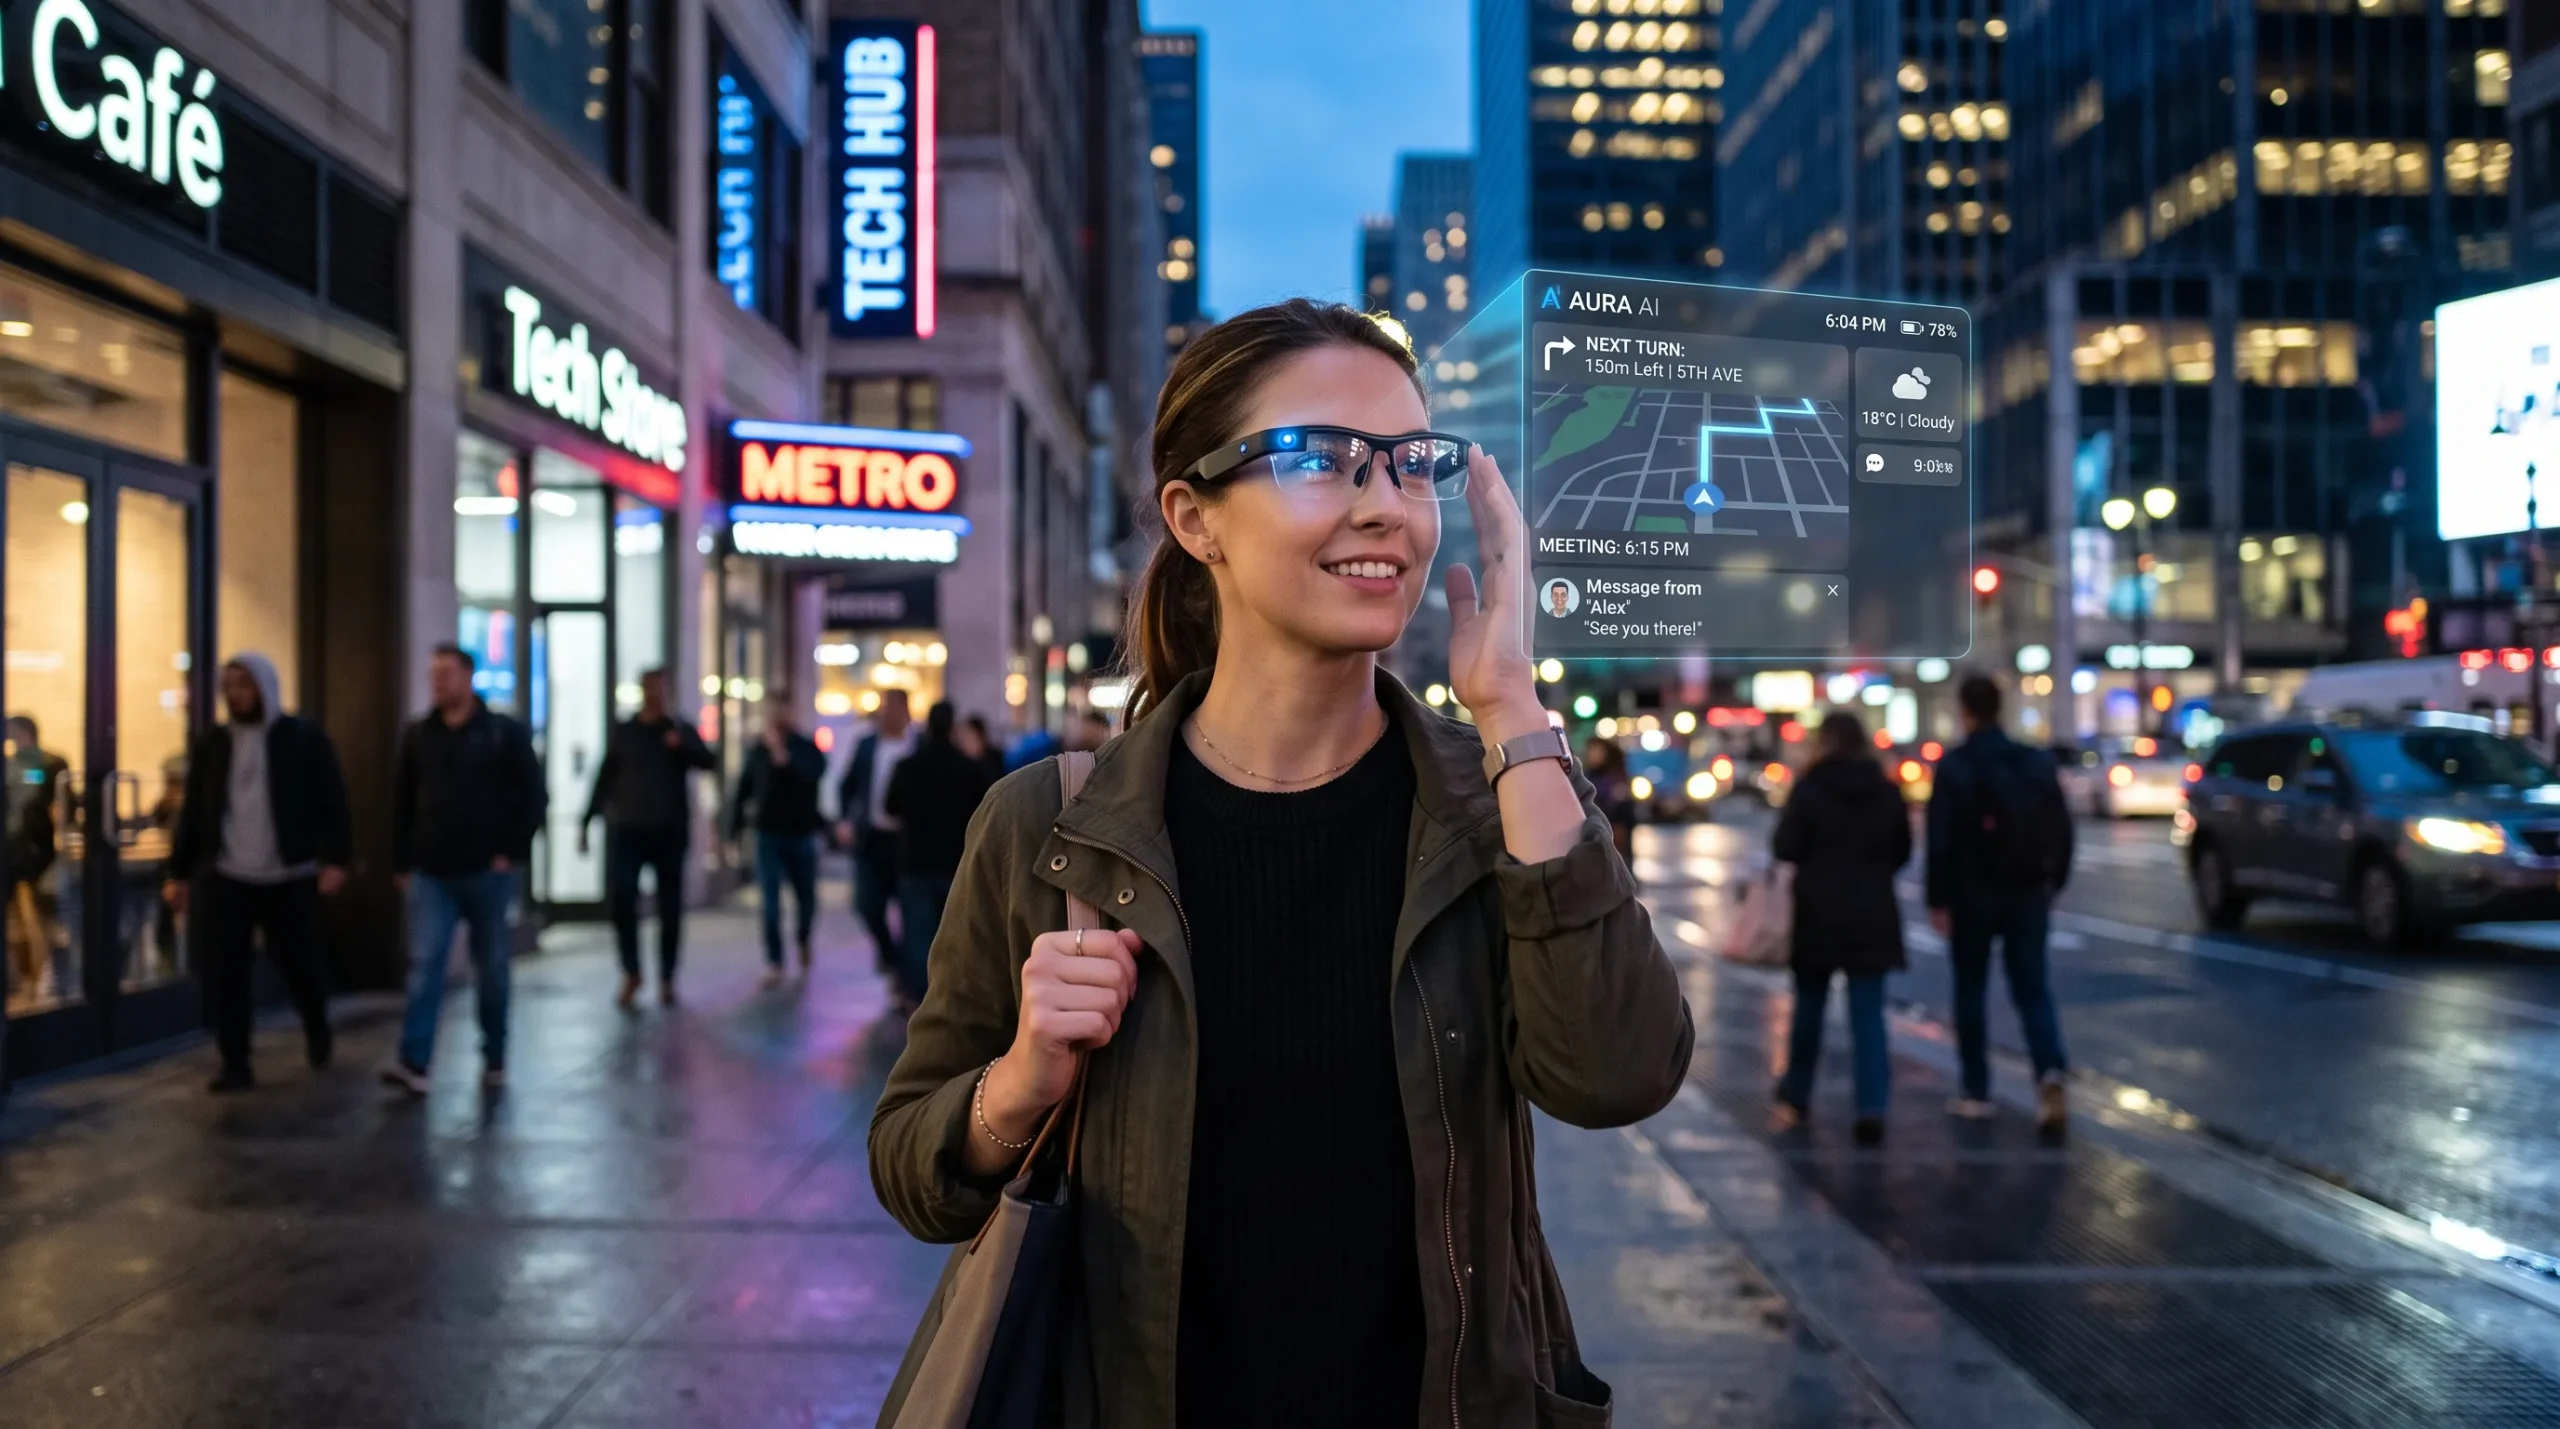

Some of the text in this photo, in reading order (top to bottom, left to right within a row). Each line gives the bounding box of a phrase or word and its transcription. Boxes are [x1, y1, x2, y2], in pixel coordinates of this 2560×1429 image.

[32, 0, 223, 208] Café
[844, 37, 906, 321] TECH HUB
[1568, 291, 1659, 316] AURA AI
[1825, 314, 1886, 332] 6:04 PM
[1928, 323, 1957, 338] 78%
[1586, 336, 1685, 357] NEXT TURN:
[504, 285, 687, 472] Tech Store
[1585, 359, 1629, 375] 150m
[1634, 361, 1664, 378] Left
[1677, 365, 1707, 381] 5TH
[1712, 367, 1743, 382] AVE
[1862, 411, 1896, 426] 18°C
[1908, 414, 1955, 433] Cloudy
[740, 441, 957, 512] METRO
[1539, 538, 1689, 556] MEETING: 6:15 PM
[1586, 579, 1702, 598] Message from
[1586, 599, 1631, 615] "Alex"
[1584, 620, 1702, 639] "See you there!"
